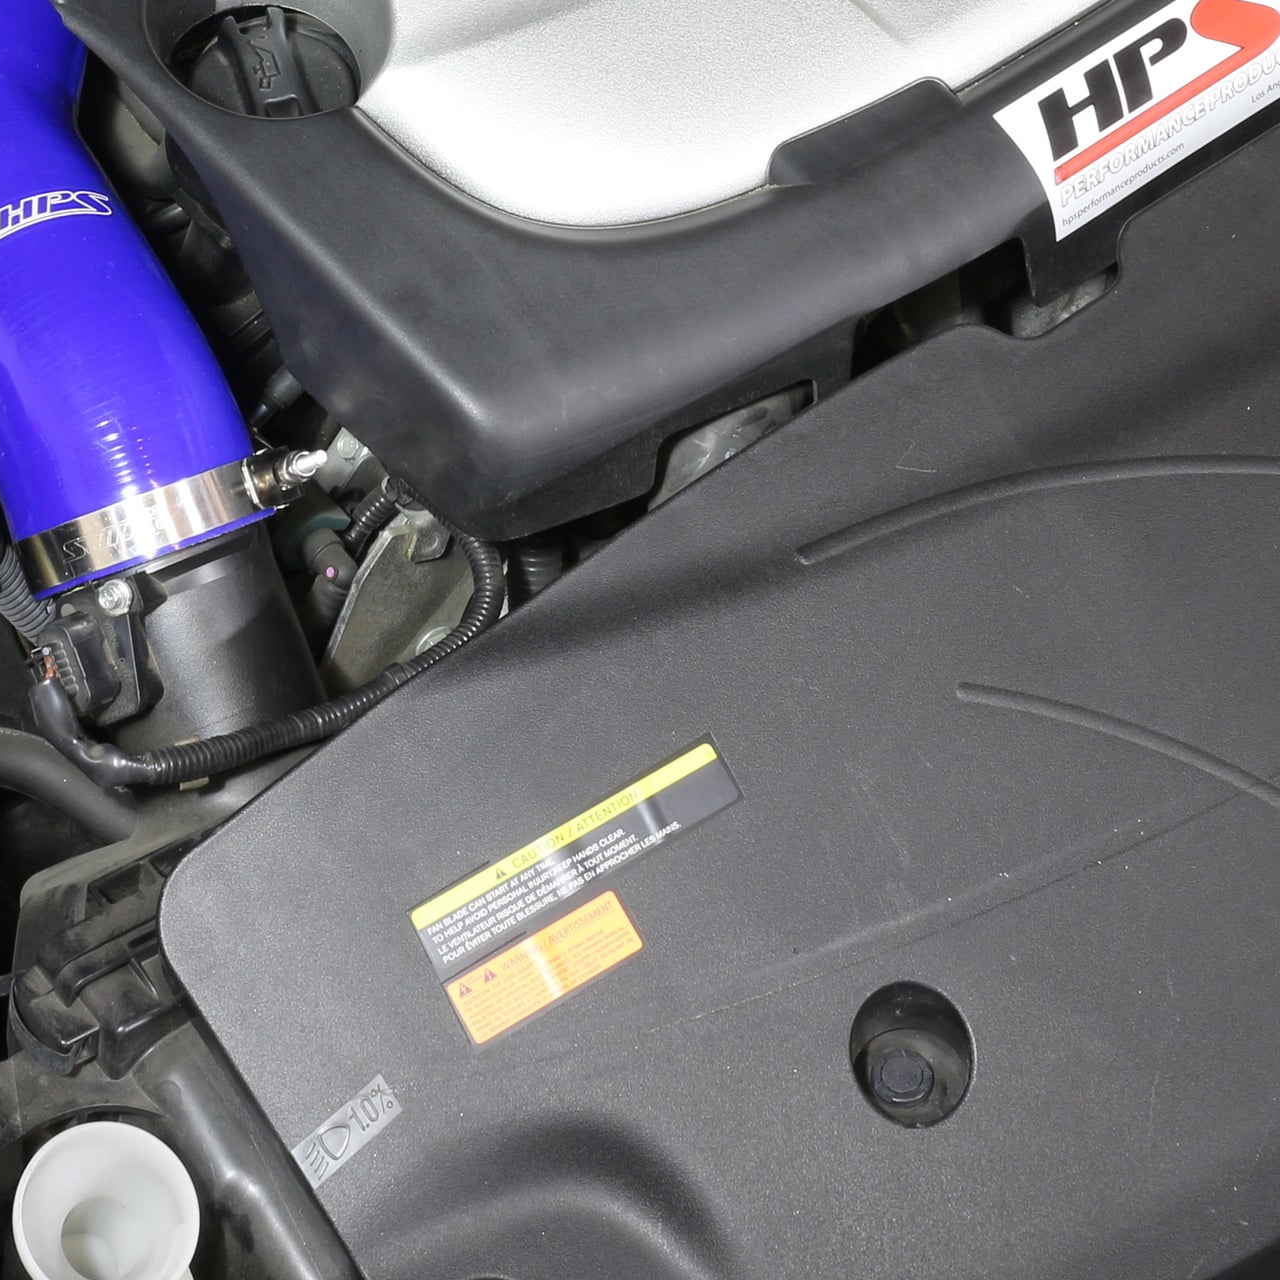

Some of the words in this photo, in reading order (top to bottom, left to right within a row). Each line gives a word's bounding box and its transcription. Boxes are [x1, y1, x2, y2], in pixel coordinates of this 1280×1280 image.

[1250, 88, 1266, 105] Los
[1060, 99, 1208, 207] PERFORMANCE
[1062, 141, 1186, 228] hpsperformanceproducts.com
[510, 831, 566, 869] CAUTION
[573, 789, 639, 833] ATTENTION
[426, 921, 444, 936] FAN
[441, 906, 469, 927] BLADE
[466, 896, 487, 912] CAN
[484, 882, 510, 902] START
[508, 876, 521, 888] AT
[518, 867, 536, 883] ANY
[431, 932, 445, 944] TO
[442, 920, 465, 938] HELP
[462, 906, 488, 926] AVOID
[486, 883, 529, 912] PERSONAL
[571, 842, 599, 863] HANDS
[597, 826, 626, 848] CLEAR.
[436, 943, 449, 955] LE
[447, 915, 498, 949] VENTILATEUR
[495, 899, 526, 921] RISQUE
[524, 892, 538, 905] DE
[534, 866, 578, 897] DÉMARRER
[582, 852, 604, 869] TOUT
[441, 945, 466, 964] POUR
[463, 928, 493, 951] ÉVITER
[490, 915, 517, 935] TOUTE
[555, 884, 570, 897] NE
[568, 876, 585, 890] PAS
[583, 869, 596, 881] EN
[594, 843, 642, 874] APPROCHER
[640, 834, 657, 848] LES
[498, 941, 543, 972] WARNG
[348, 1083, 394, 1132] 1.0%
